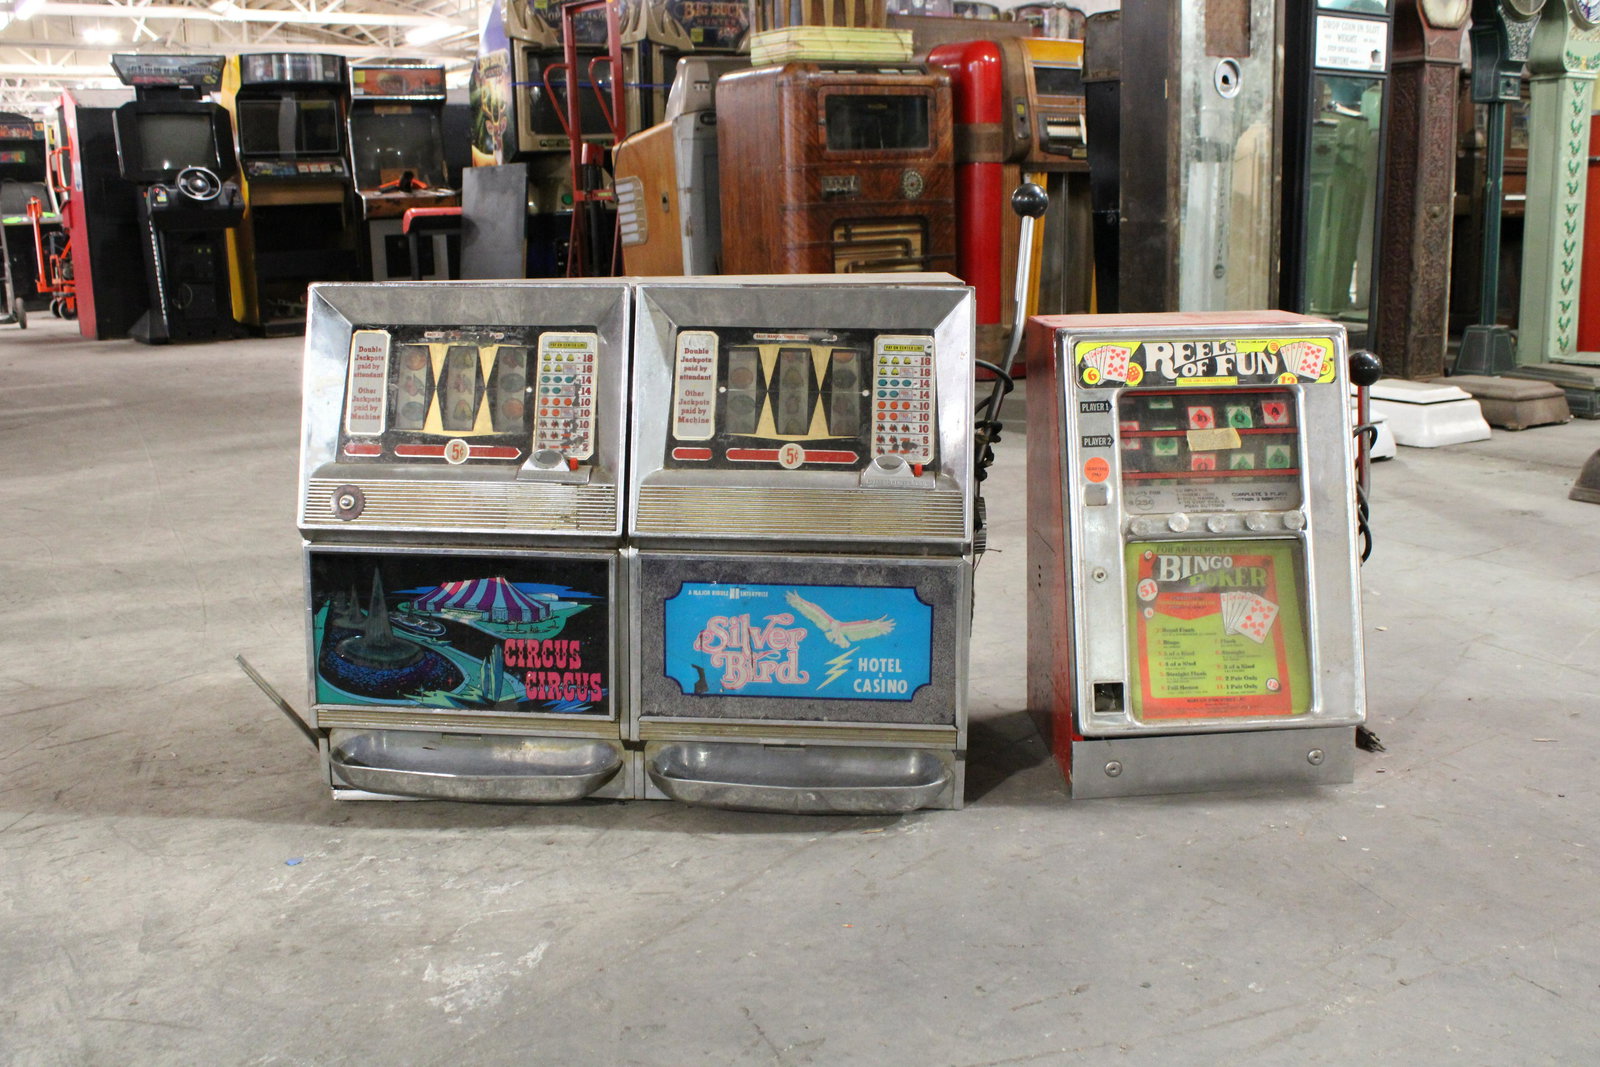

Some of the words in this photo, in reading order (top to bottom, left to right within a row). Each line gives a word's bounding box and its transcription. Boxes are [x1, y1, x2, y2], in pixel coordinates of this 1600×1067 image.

[681, 2, 709, 19] BIG
[582, 354, 594, 363] 18
[681, 356, 712, 365] Jackpots
[920, 357, 931, 366] 18
[1144, 341, 1237, 379] REELS
[582, 365, 593, 373] 18
[1182, 362, 1208, 377] OF
[1216, 352, 1279, 376] FUN
[920, 368, 931, 377] 18
[1088, 369, 1098, 381] 6
[581, 376, 592, 384] 14
[920, 380, 930, 388] 14
[581, 387, 591, 396] 14
[919, 391, 930, 399] 14
[580, 398, 591, 406] 10
[679, 399, 710, 407] Jackpots
[919, 402, 930, 411] 10
[1082, 403, 1105, 412] PLAYER
[580, 409, 591, 417] 10
[919, 413, 930, 422] 10
[678, 416, 710, 424] Machine
[579, 421, 590, 429] 10
[919, 425, 929, 433] 10
[1084, 437, 1106, 447] PLAYER
[452, 444, 464, 461] 5¢
[582, 444, 589, 452] 2
[922, 448, 929, 457] 2
[786, 448, 798, 465] 5¢
[1157, 555, 1233, 582] BINGO
[1189, 566, 1267, 587] POKER
[1140, 582, 1157, 598] 51
[694, 614, 808, 651] Silver
[504, 638, 582, 670] CIRCUS
[858, 658, 902, 673] HOTEL
[711, 650, 810, 691] Bird
[526, 671, 603, 702] CIRCUS
[853, 679, 908, 694] CASINO
